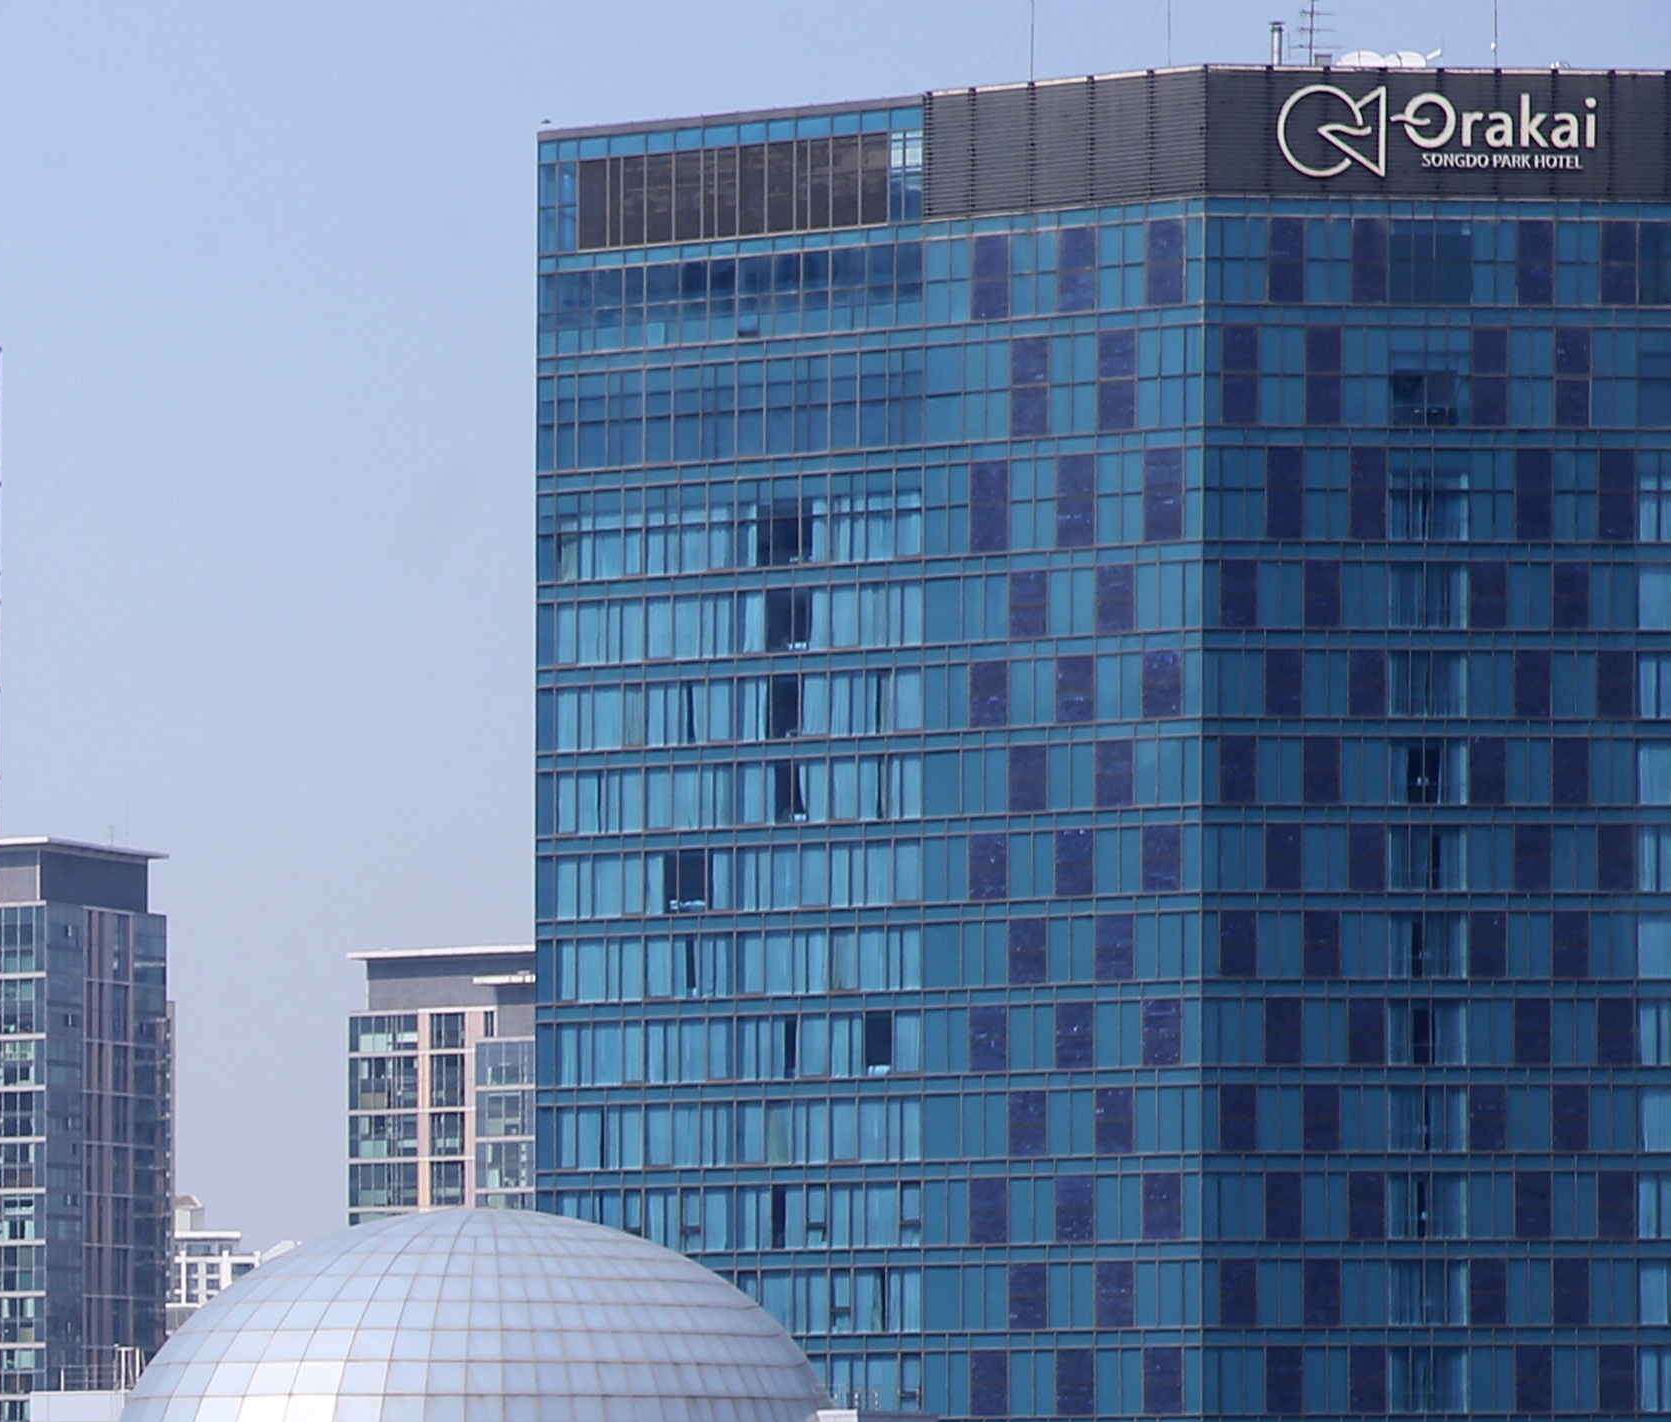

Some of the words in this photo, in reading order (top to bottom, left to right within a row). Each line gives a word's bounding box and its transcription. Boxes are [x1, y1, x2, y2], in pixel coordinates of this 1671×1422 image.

[1391, 92, 1598, 149] Orakai
[1421, 153, 1490, 168] SONGDO
[1492, 154, 1531, 169] PARK
[1533, 154, 1583, 170] HOTEL
